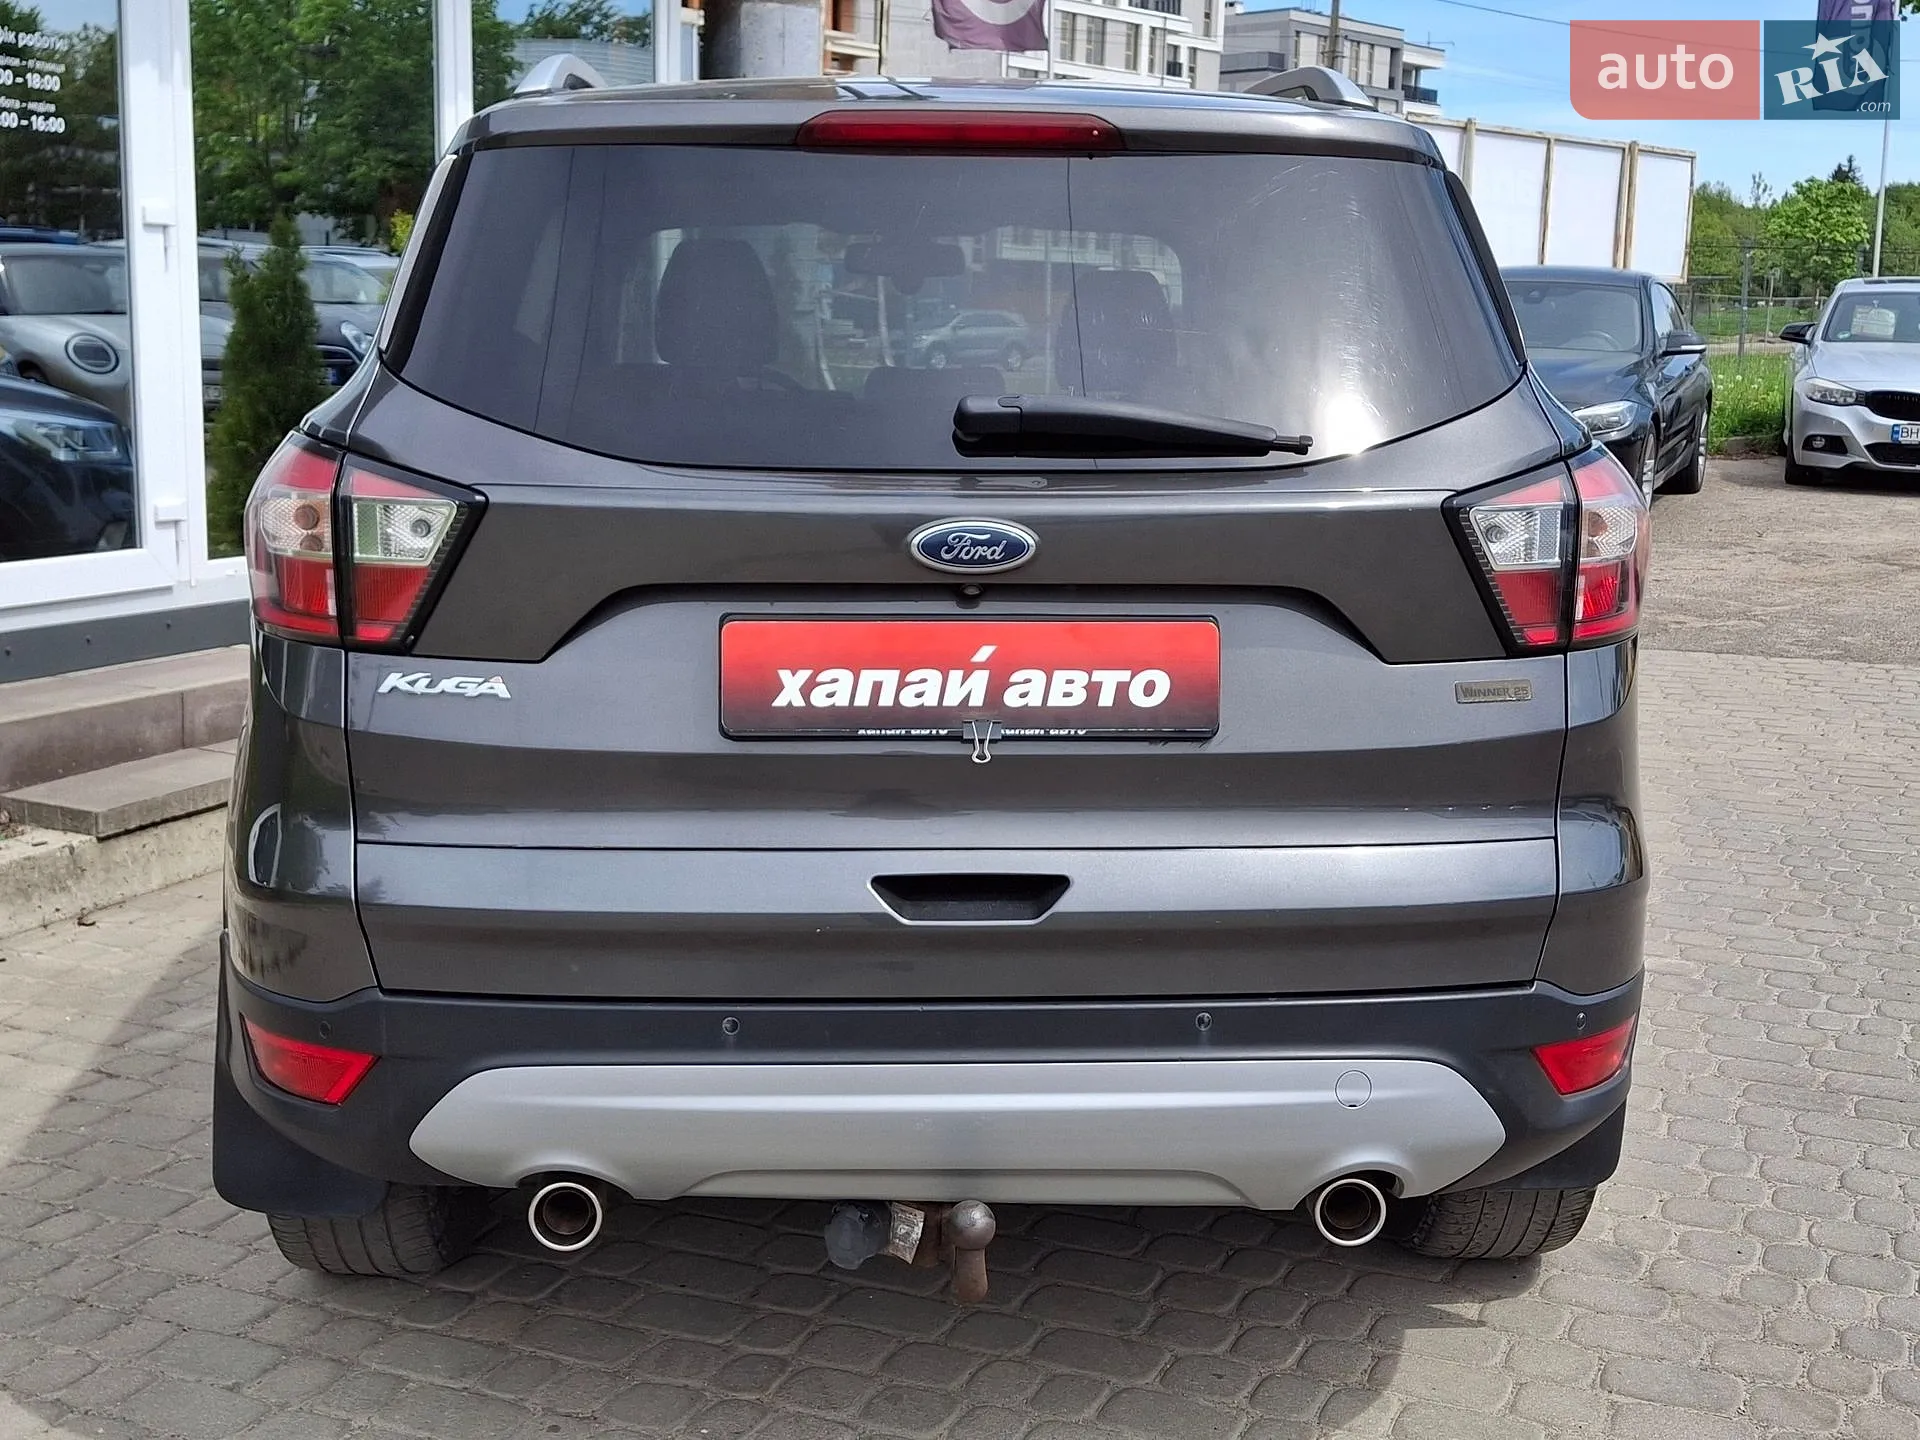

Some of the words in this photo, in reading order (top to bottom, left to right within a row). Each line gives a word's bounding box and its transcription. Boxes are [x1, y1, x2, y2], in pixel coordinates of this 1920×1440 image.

[25, 72, 61, 92] 18:00
[30, 114, 66, 134] 16:00
[1901, 426, 1919, 439] BH
[940, 532, 1007, 560] Ford
[377, 672, 511, 699] KUGA
[772, 645, 997, 708] хапай
[1003, 668, 1171, 708] авто
[1460, 685, 1512, 698] WINNER
[1513, 686, 1529, 696] 25
